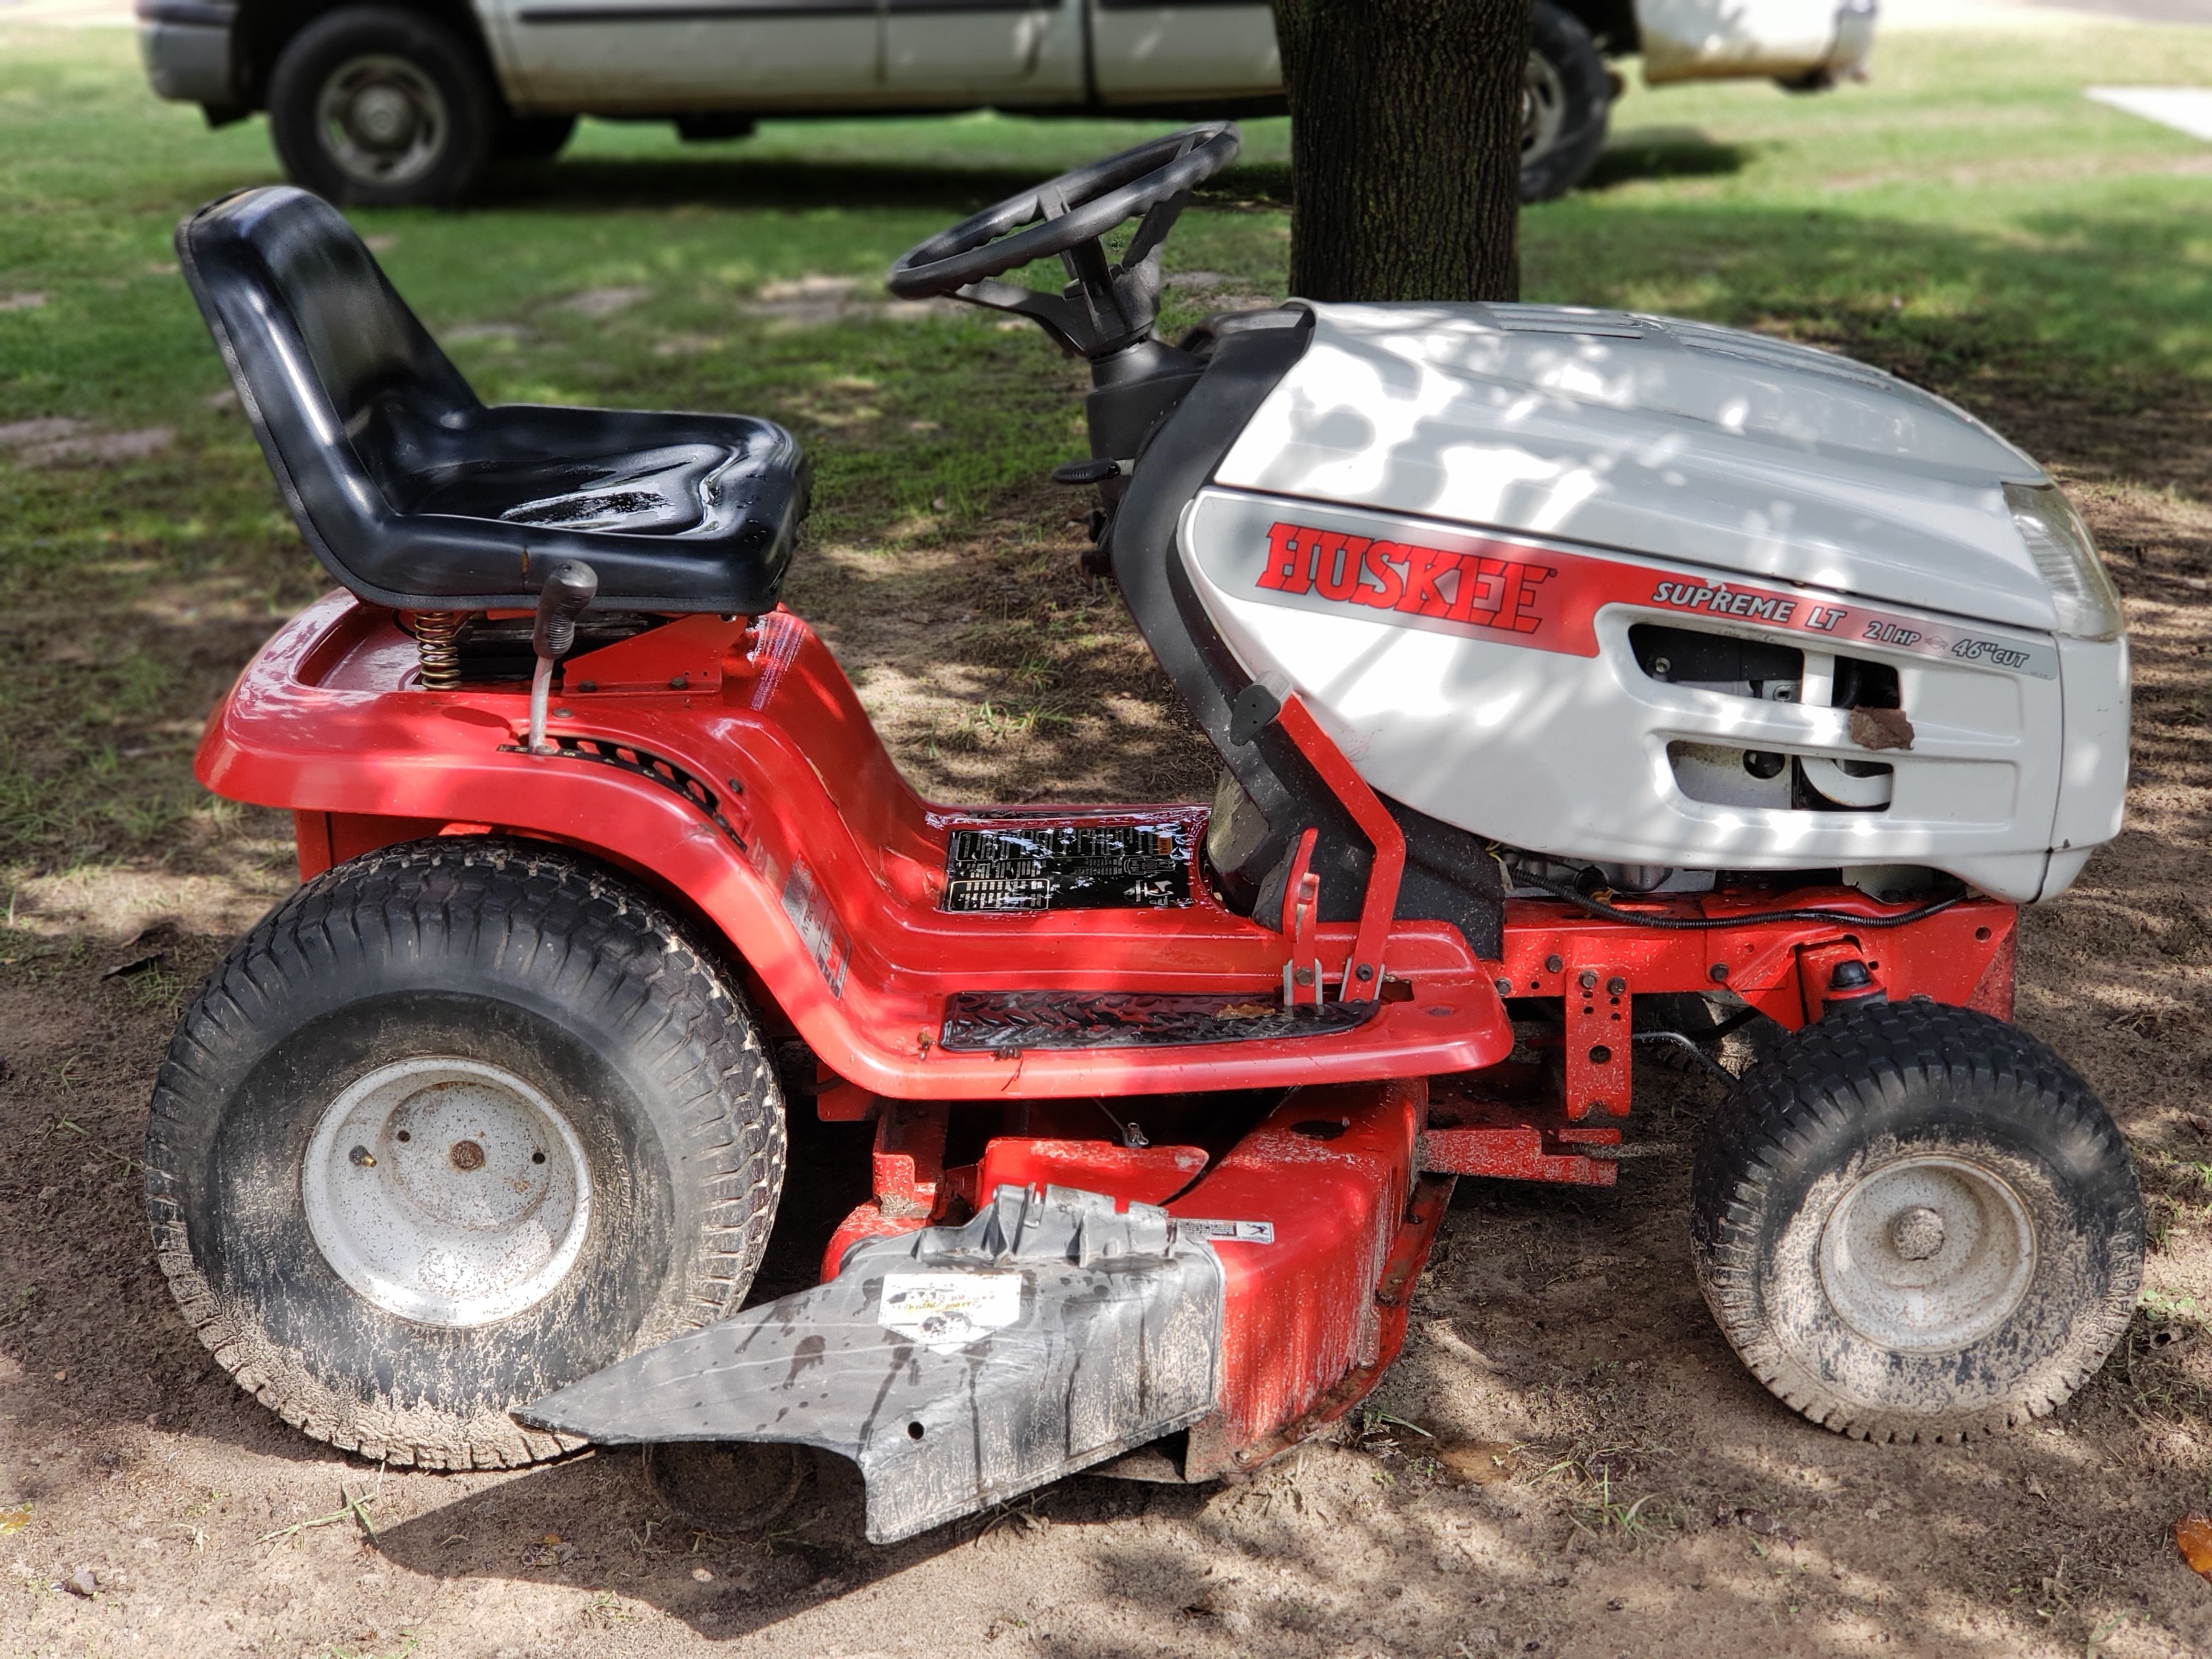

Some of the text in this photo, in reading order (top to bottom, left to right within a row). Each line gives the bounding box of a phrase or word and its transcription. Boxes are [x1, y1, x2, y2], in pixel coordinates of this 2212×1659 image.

[1255, 521, 1553, 634] HUSKEE
[1652, 582, 1797, 623] SUPREME
[1805, 606, 1847, 631] LT
[1863, 620, 1922, 646] 21HP
